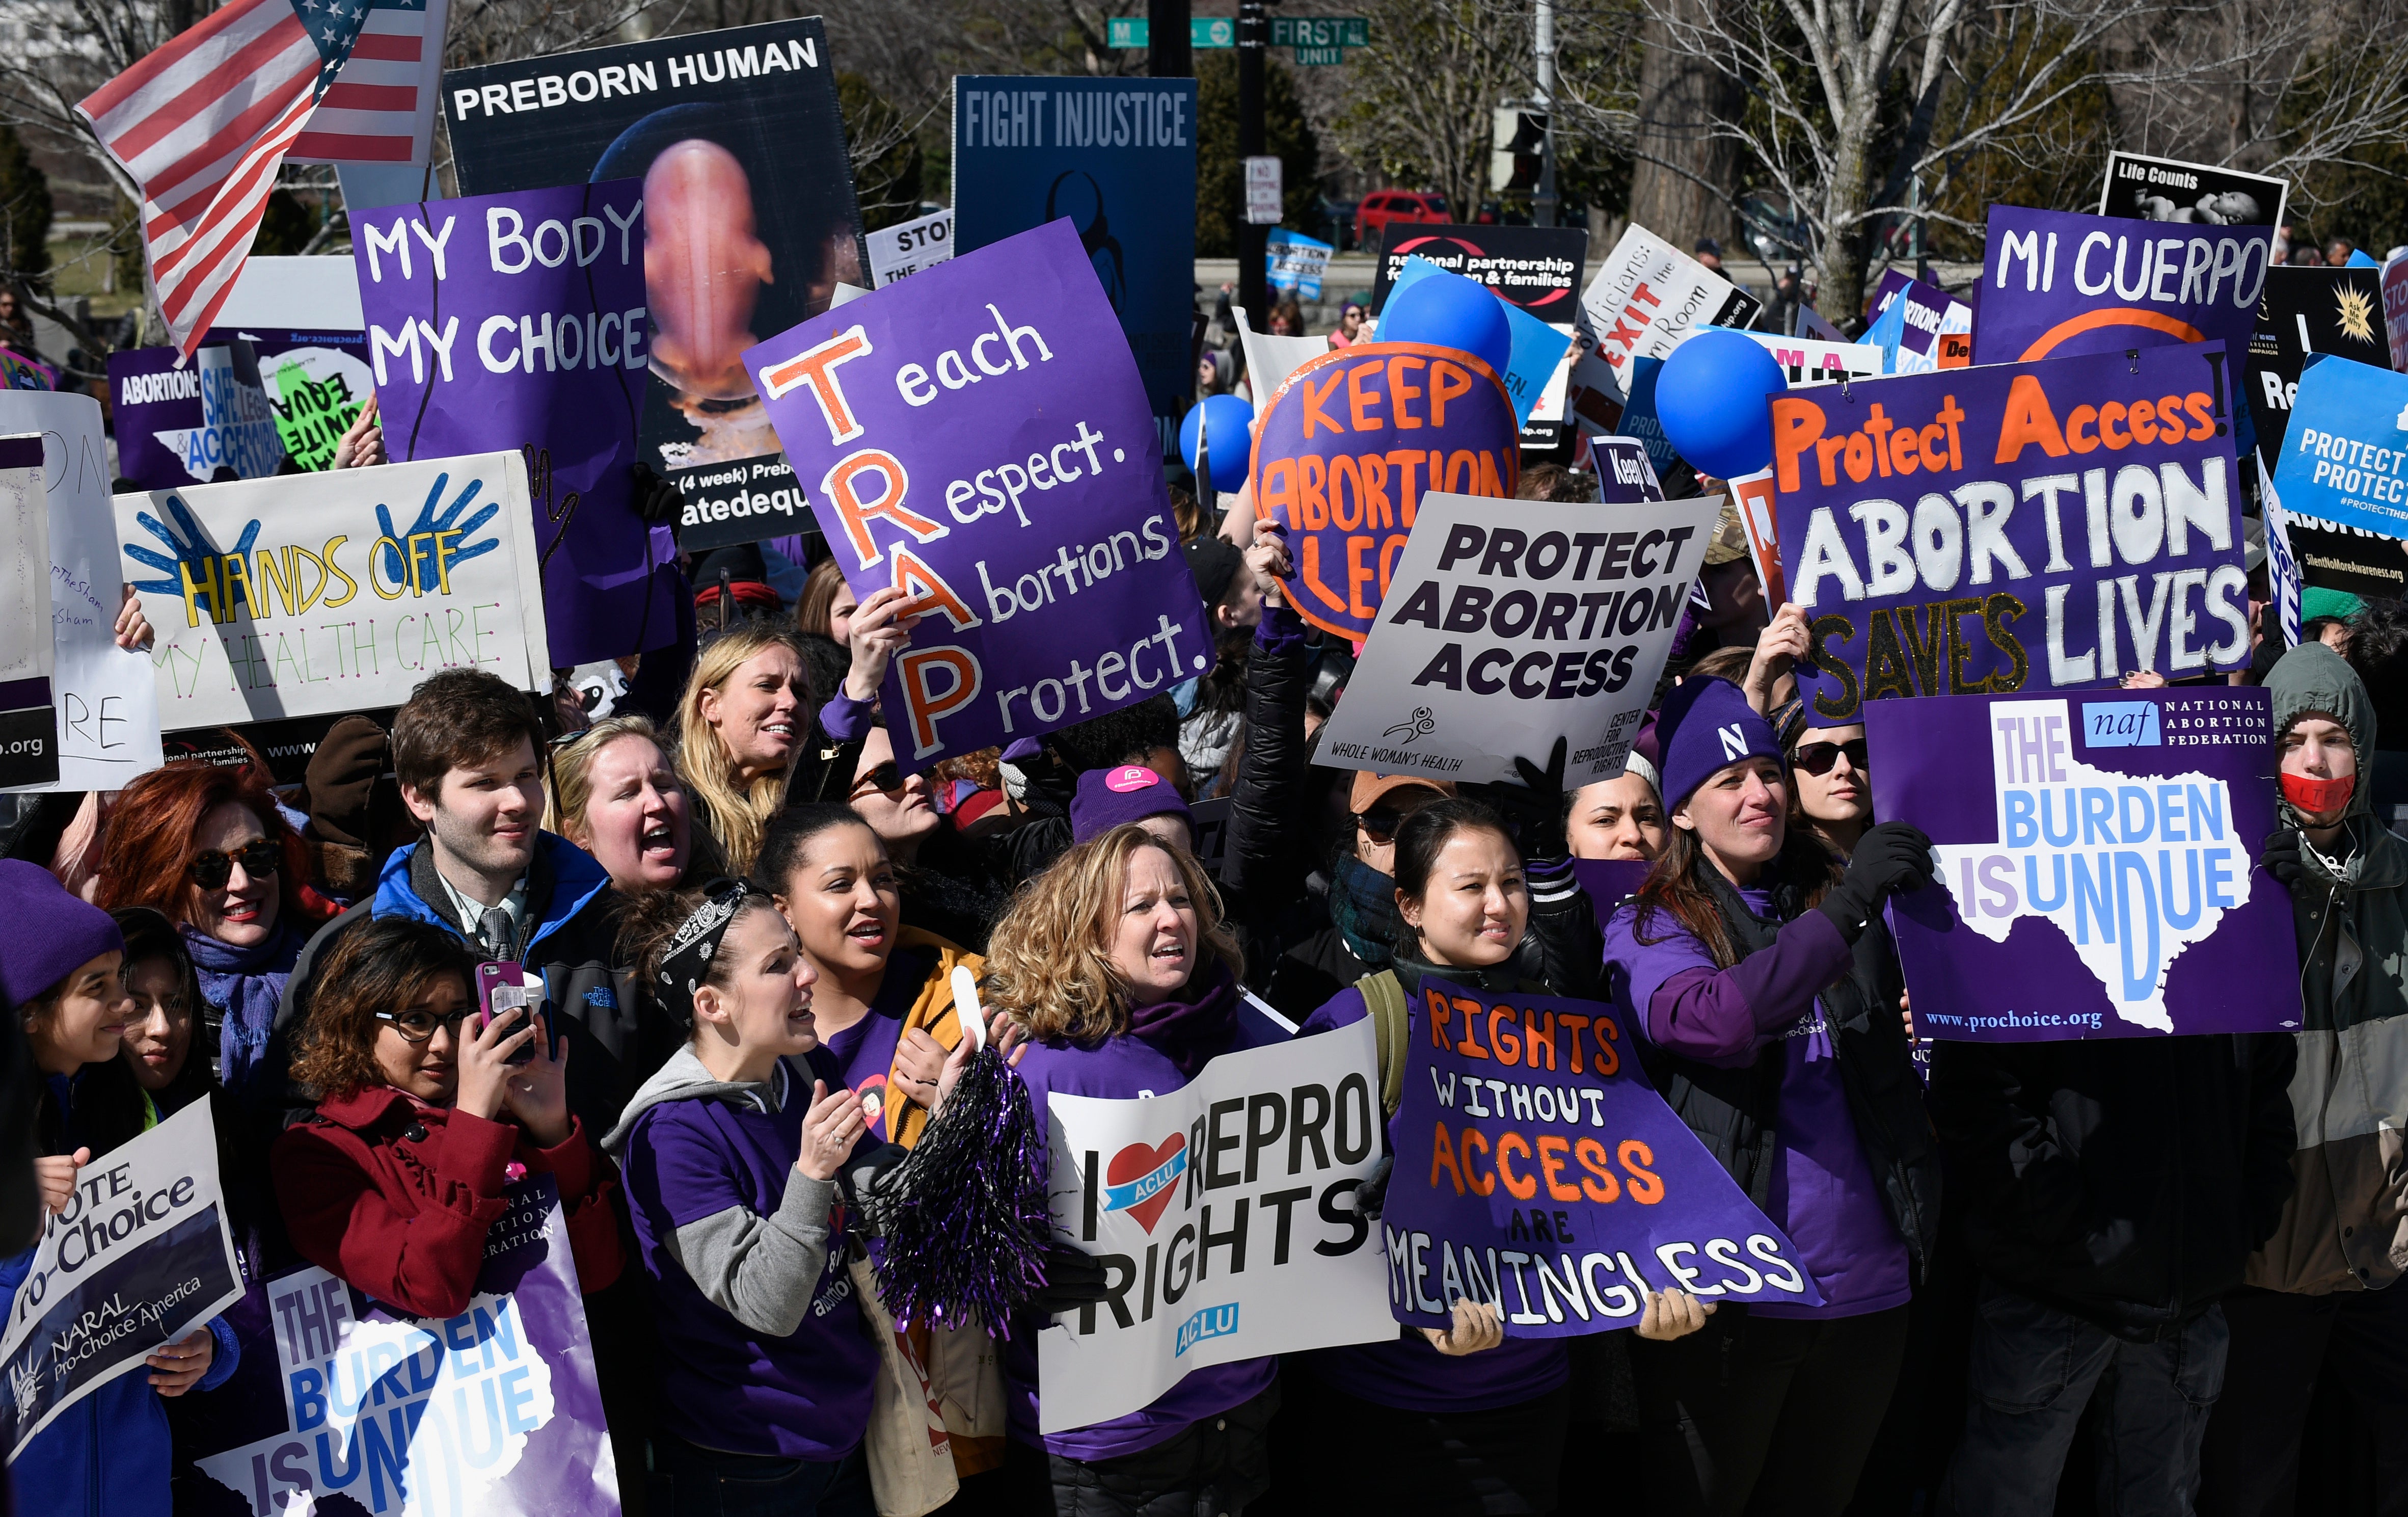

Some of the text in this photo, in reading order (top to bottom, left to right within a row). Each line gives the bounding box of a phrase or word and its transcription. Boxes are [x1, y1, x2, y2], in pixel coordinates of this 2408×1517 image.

[1274, 20, 1344, 46] FIRST
[1296, 48, 1339, 64] UNIT
[453, 38, 818, 121] PREBORN HUMAN
[966, 91, 1187, 147] FIGHT INJUSTICE
[2118, 162, 2198, 191] Life Counts
[364, 199, 643, 283] MY BODY
[897, 218, 951, 252] STO
[1388, 252, 1575, 275] naional partnership
[1485, 270, 1501, 285] &
[1504, 272, 1572, 287] families
[1997, 229, 2268, 309] MI CUERPO
[1594, 261, 1675, 369] EXIT the
[1654, 284, 1710, 341] Room
[2346, 316, 2361, 330] Why
[2349, 301, 2361, 313] Ask
[2349, 309, 2360, 320] Me
[370, 307, 647, 386] MY CHOICE
[121, 369, 200, 406] ABORTION:
[1303, 355, 1473, 440] KEEP
[177, 433, 188, 454] &
[1772, 393, 1965, 493] Protect
[2299, 428, 2406, 476] PROTECT
[679, 463, 797, 494] (4 week) Preb
[1260, 447, 1516, 532] ABORTION
[1608, 447, 1645, 493] Keep
[1437, 523, 1695, 581] PROTECT
[1792, 455, 2233, 608] ABORTION
[179, 528, 463, 628] HANDS OFF
[2305, 552, 2404, 583] SilentNoMoreAwareness.org
[1389, 580, 1687, 641] ABORTION
[224, 619, 380, 691] HEALTH
[395, 602, 501, 671] CARE
[1811, 592, 2029, 720] SAVES
[2045, 564, 2251, 686] LIVES
[1411, 643, 1640, 701] ACCESS
[1610, 708, 1641, 729] CENTER
[2093, 701, 2158, 747] naf
[2165, 700, 2265, 712] NATIONAL
[2166, 716, 2266, 729] ABORTION
[191, 746, 247, 761] partnership
[1332, 741, 1464, 774] WHOLE WOMAN'S HEALTH
[1571, 739, 1630, 765] REPRODUCTIVE
[1604, 728, 1622, 744] FOR
[1717, 723, 1751, 762] N
[1997, 716, 2067, 784] THE
[2168, 733, 2267, 746] FEDERATION
[212, 756, 249, 767] families
[1591, 755, 1624, 775] RIGHTS
[2003, 783, 2224, 849] BURDEN
[1960, 847, 2235, 1003] IS UNDUE
[582, 992, 611, 1000] NORTH
[589, 999, 611, 1007] FACE
[1425, 986, 1621, 1077] RIGHTS
[1925, 1009, 2103, 1033] www.prochoice.org
[1429, 1064, 1604, 1127] WITHOUT
[1083, 1072, 1373, 1242] I REPRO
[1429, 1121, 1666, 1206] ACCESS
[1134, 1162, 1175, 1202] ACLU
[1510, 1208, 1575, 1244] ARE
[1078, 1178, 1370, 1336] RIGHTS
[1385, 1223, 1805, 1326] MEANINGLESS
[51, 1292, 131, 1363] NARAL
[54, 1276, 202, 1382] Pro-Choice America
[275, 1277, 351, 1366] THE
[1177, 1307, 1234, 1356] ACLU
[288, 1297, 519, 1434] BURDEN
[251, 1365, 539, 1517] IS UNDUE
